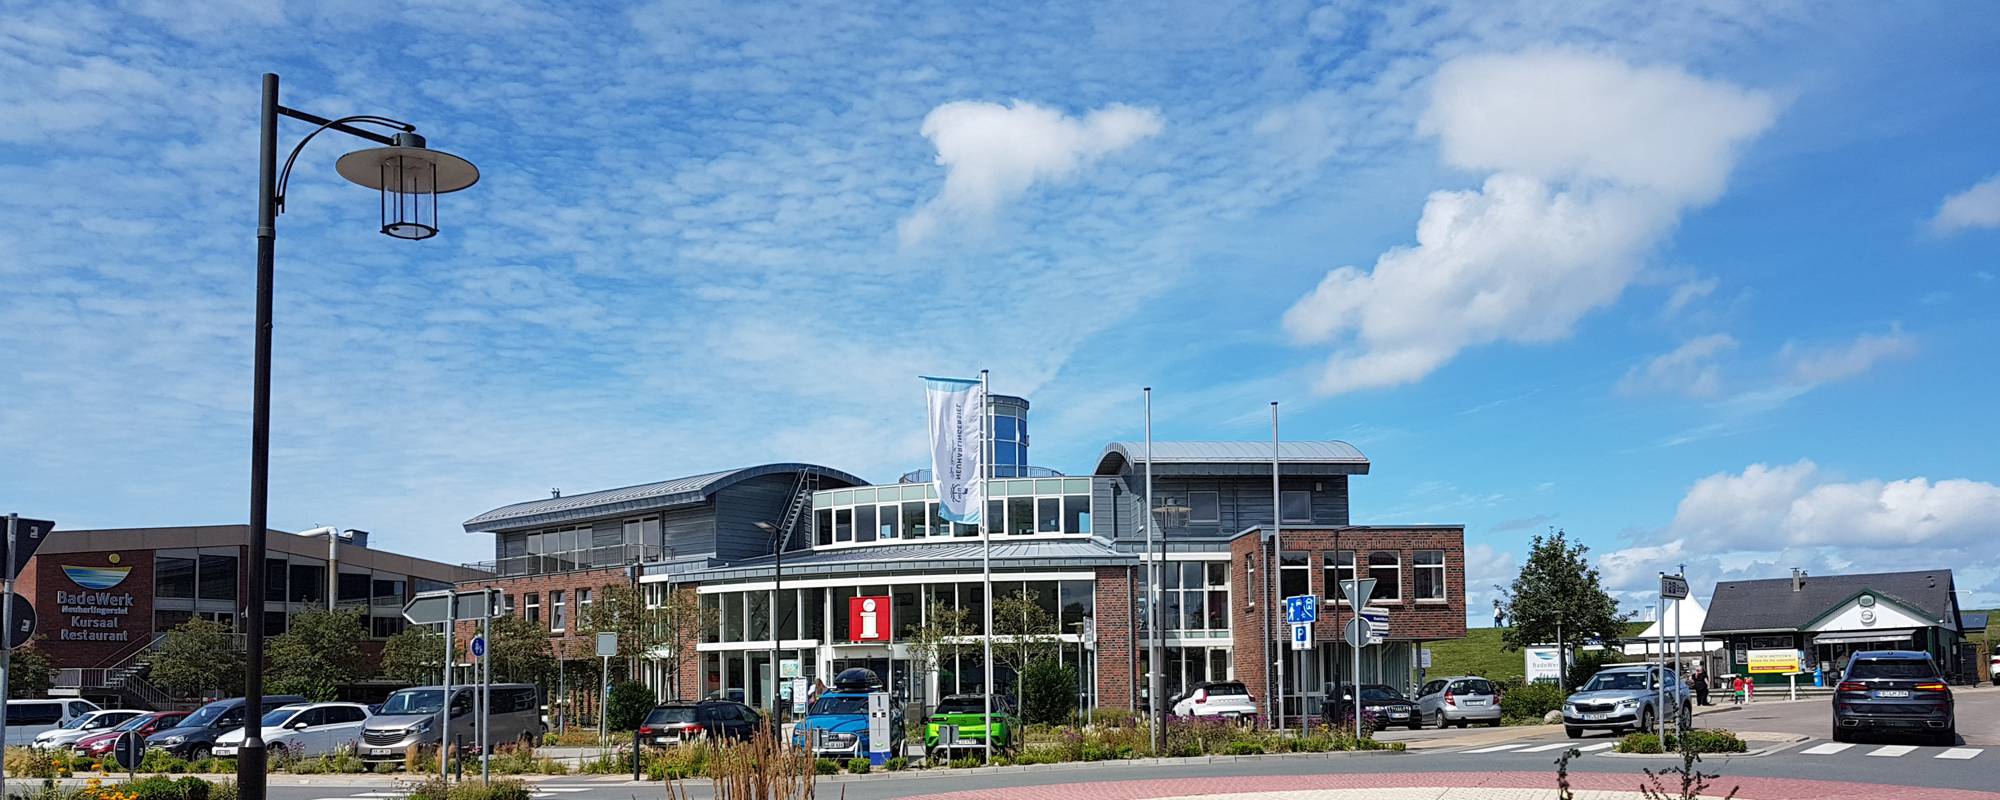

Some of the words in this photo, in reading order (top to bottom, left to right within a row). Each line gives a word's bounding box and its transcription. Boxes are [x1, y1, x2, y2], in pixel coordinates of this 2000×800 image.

[57, 591, 134, 606] BadeWerk
[61, 605, 128, 615] Neuharlingersiel
[71, 616, 118, 628] Kursaal
[60, 629, 128, 641] Restaurant
